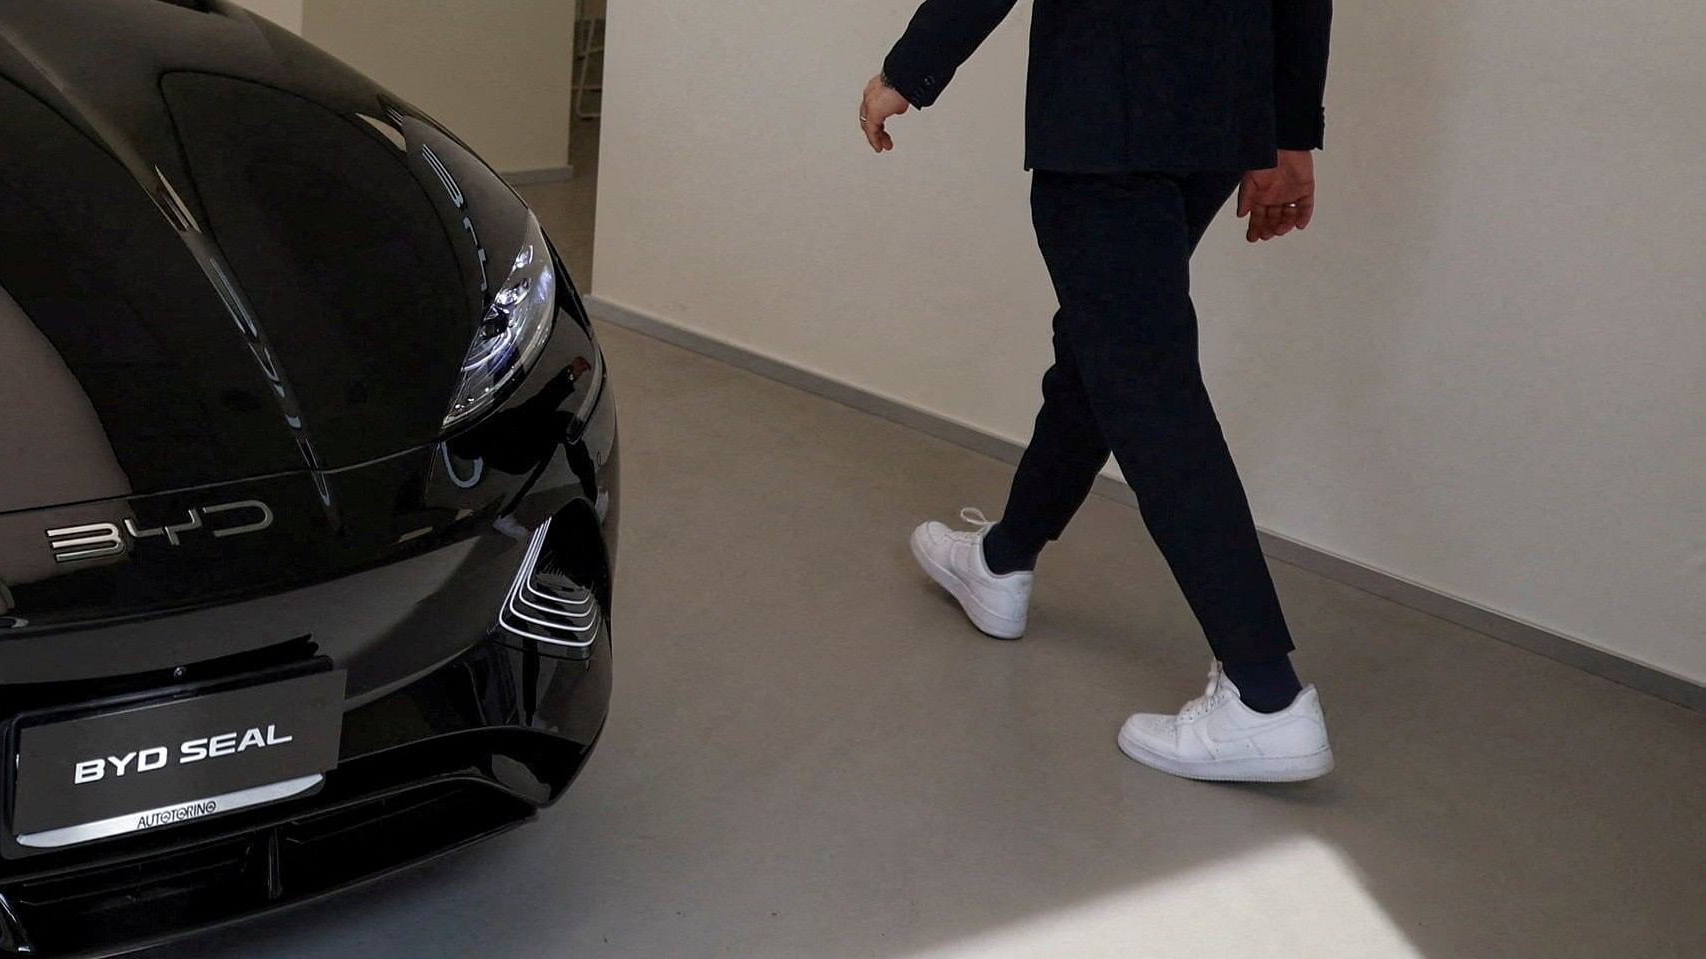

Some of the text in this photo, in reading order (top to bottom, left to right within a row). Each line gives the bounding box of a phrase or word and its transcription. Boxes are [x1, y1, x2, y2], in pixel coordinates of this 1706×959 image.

[45, 499, 275, 563] BYD
[74, 724, 293, 784] BYD SEAL
[137, 800, 217, 829] AUTOTORINO
